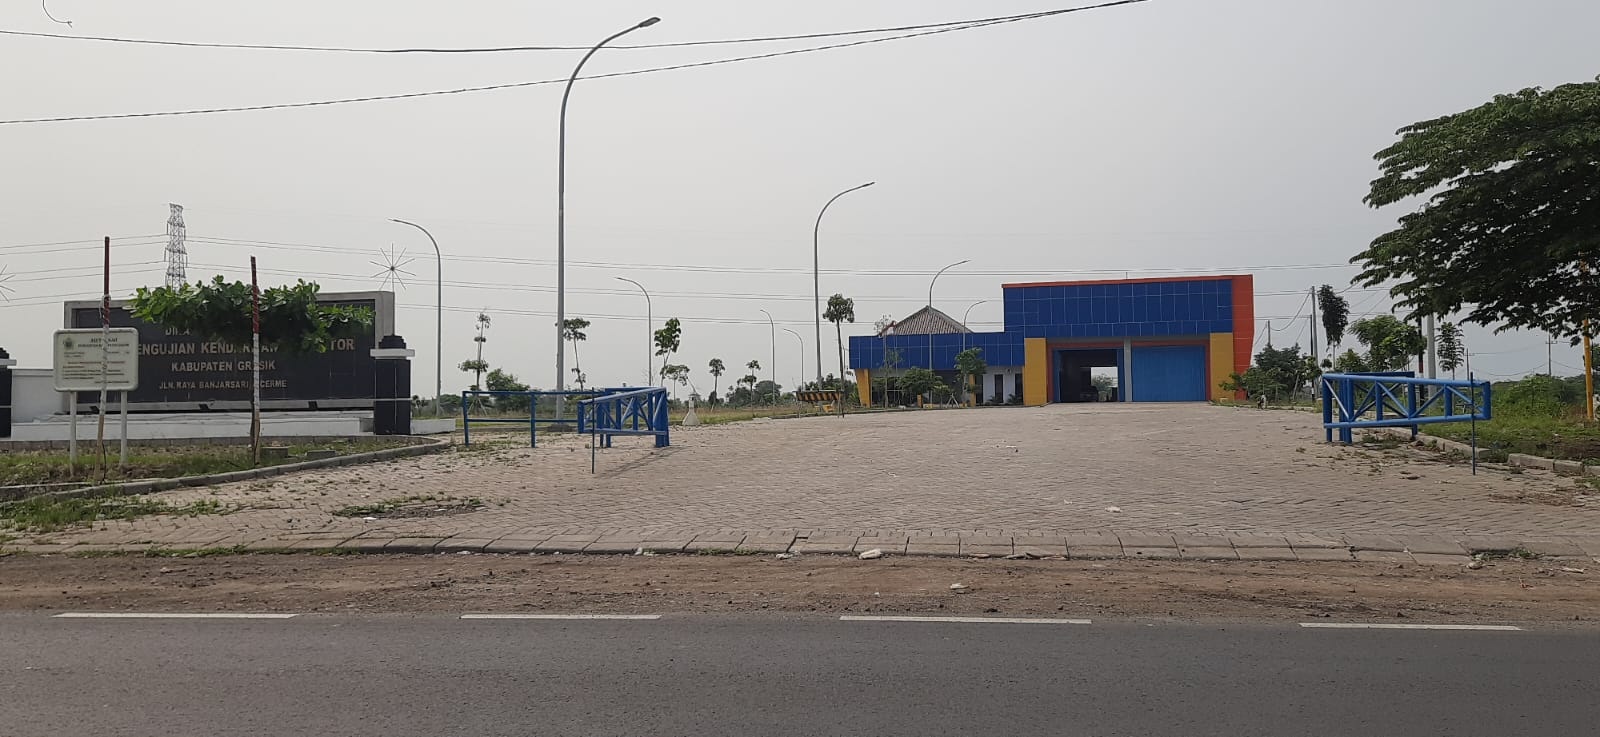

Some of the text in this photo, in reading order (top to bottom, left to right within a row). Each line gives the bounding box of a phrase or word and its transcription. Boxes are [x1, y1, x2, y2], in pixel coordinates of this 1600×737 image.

[138, 343, 195, 355] ENGUJIAN
[171, 360, 276, 372] KABUPATEN GRSIK
